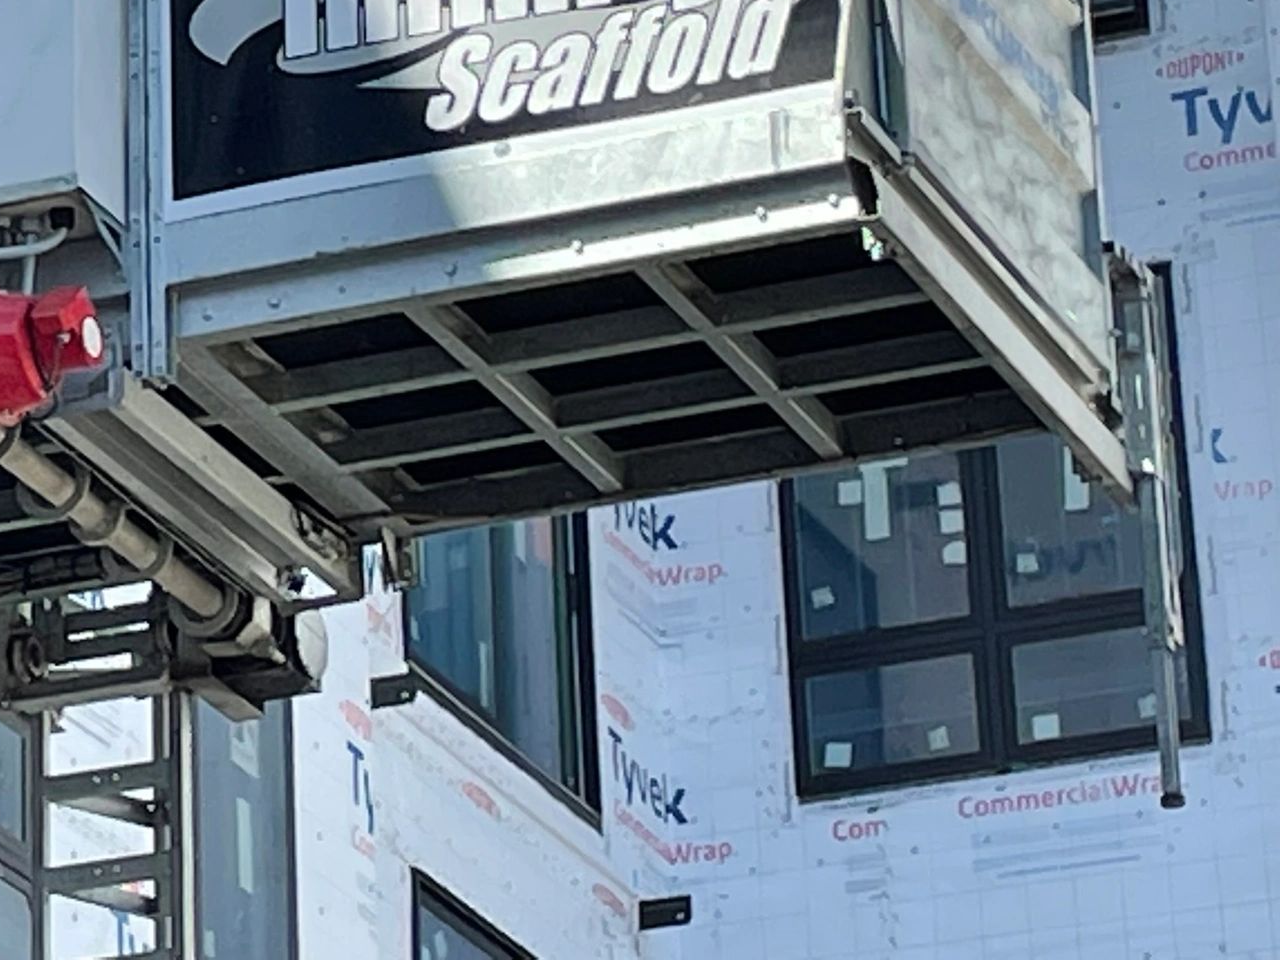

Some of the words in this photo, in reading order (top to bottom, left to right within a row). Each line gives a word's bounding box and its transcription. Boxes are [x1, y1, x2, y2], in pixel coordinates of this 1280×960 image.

[1166, 50, 1234, 79] DUPONT
[608, 725, 689, 825] Tyvek
[958, 772, 1162, 820] CommercialWra
